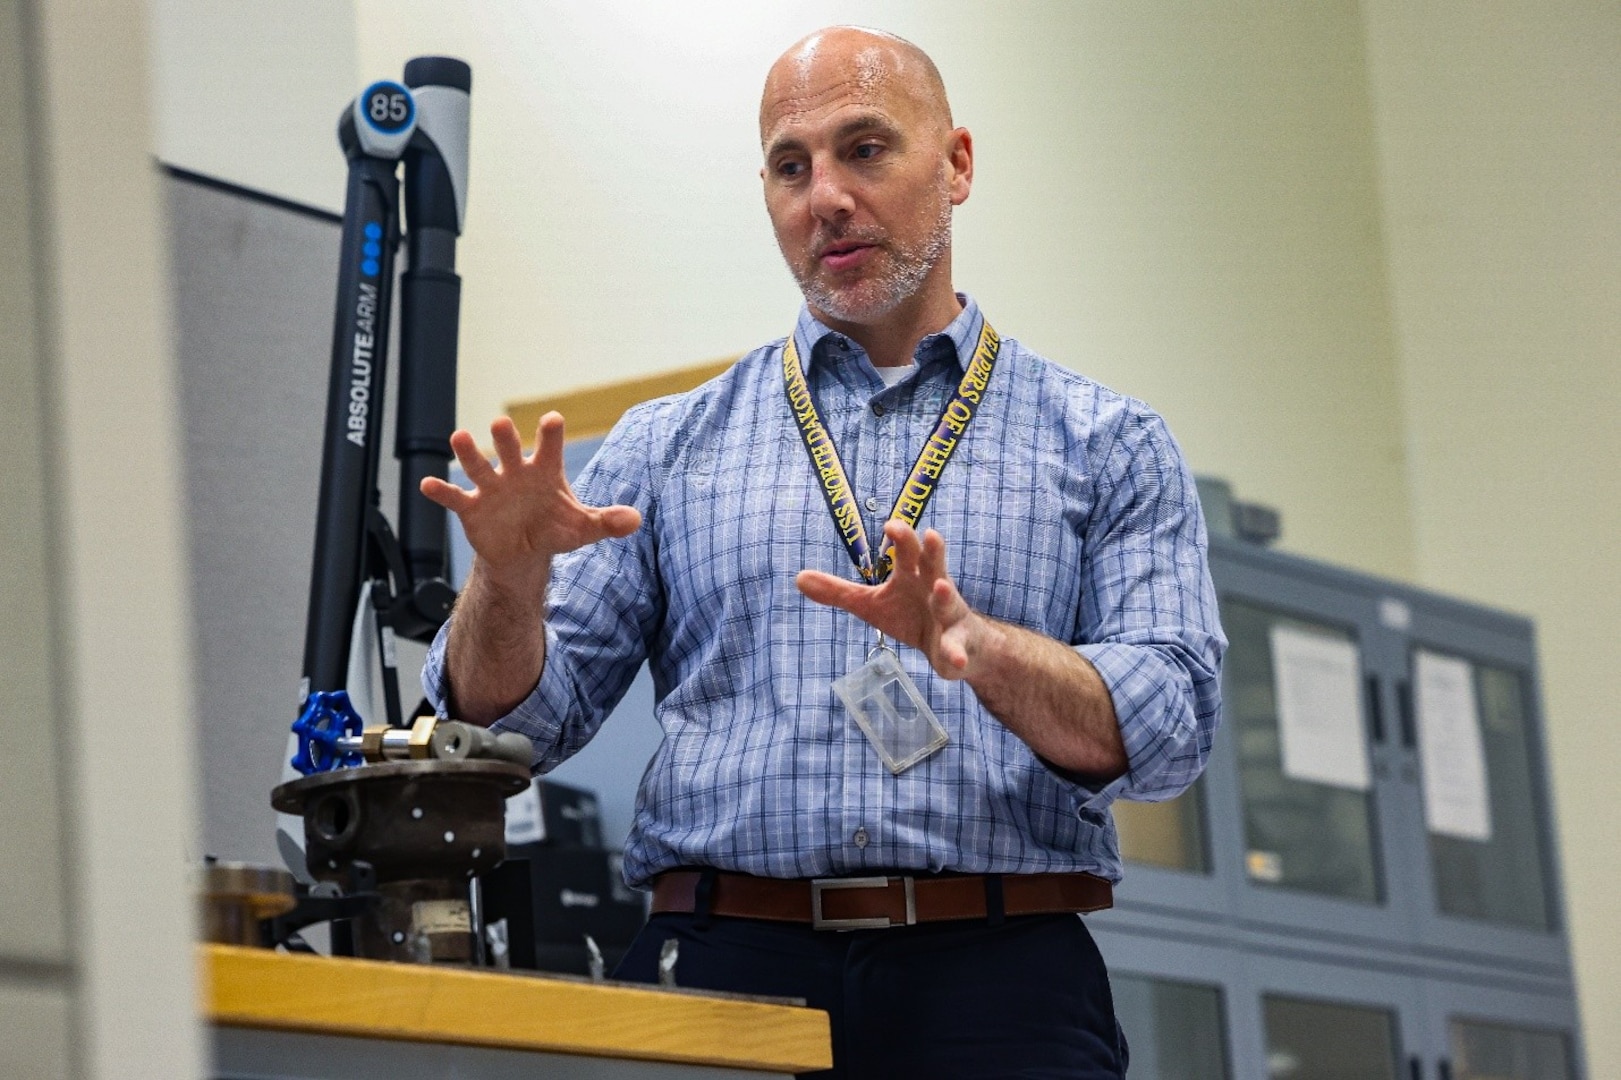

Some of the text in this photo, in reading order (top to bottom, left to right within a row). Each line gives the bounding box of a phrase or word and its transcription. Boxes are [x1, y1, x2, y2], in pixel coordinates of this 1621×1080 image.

[370, 93, 407, 122] 85
[787, 375, 827, 445] DAKOTA
[942, 398, 971, 435] OF
[811, 438, 847, 505] NORTH
[912, 433, 956, 480] THE
[834, 502, 862, 547] USS
